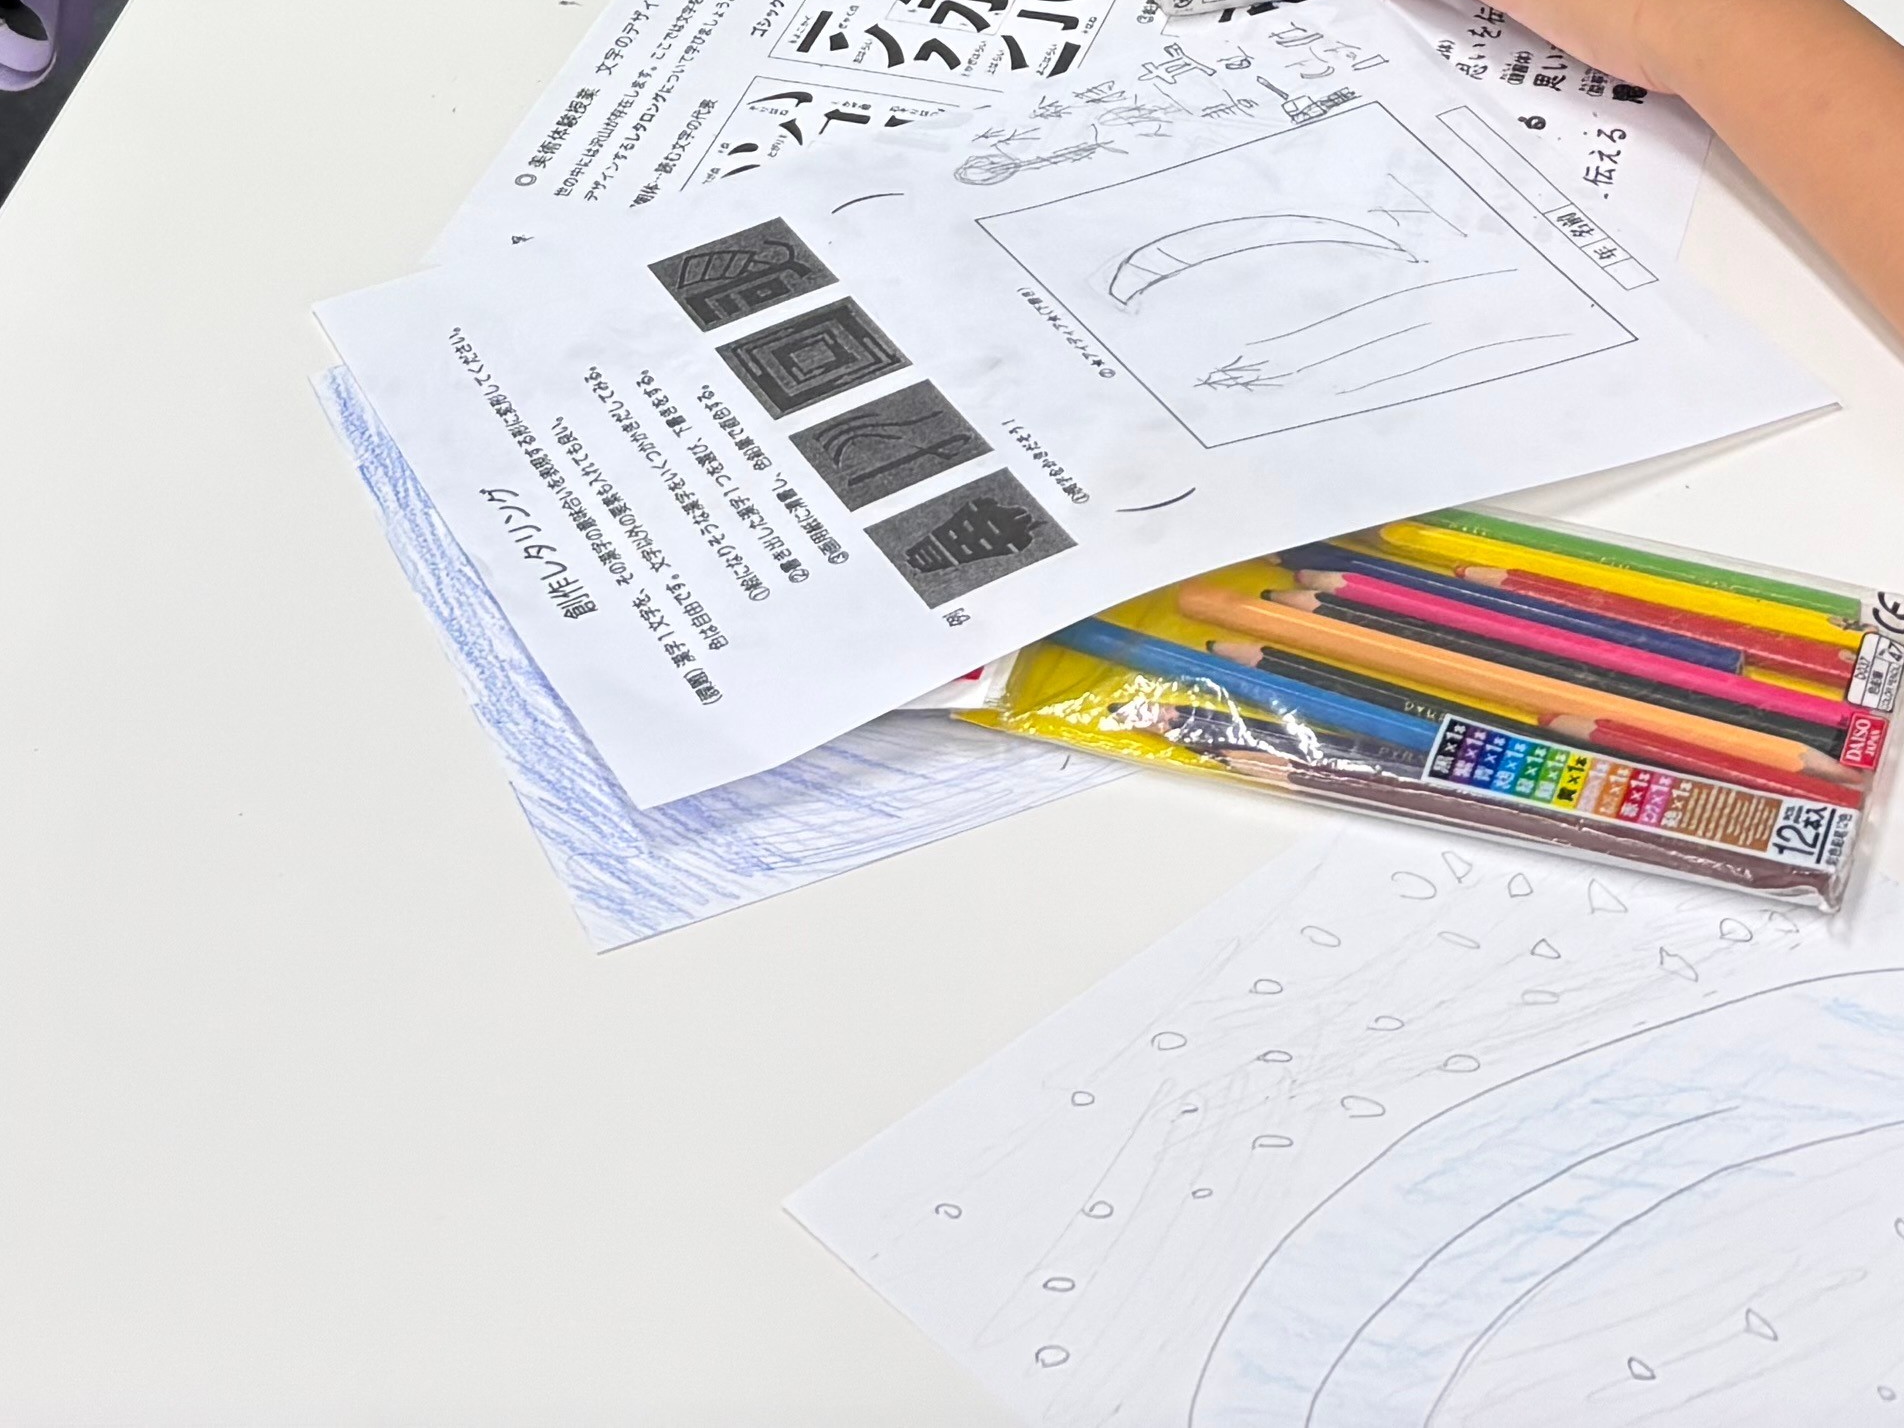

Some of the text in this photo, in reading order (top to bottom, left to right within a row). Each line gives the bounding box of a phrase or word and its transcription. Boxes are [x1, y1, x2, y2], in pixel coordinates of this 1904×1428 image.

[1533, 44, 1568, 91] 思い
[1557, 212, 1595, 238] 名前
[478, 488, 599, 620] 創作レタリング
[1846, 719, 1871, 762] DAISO
